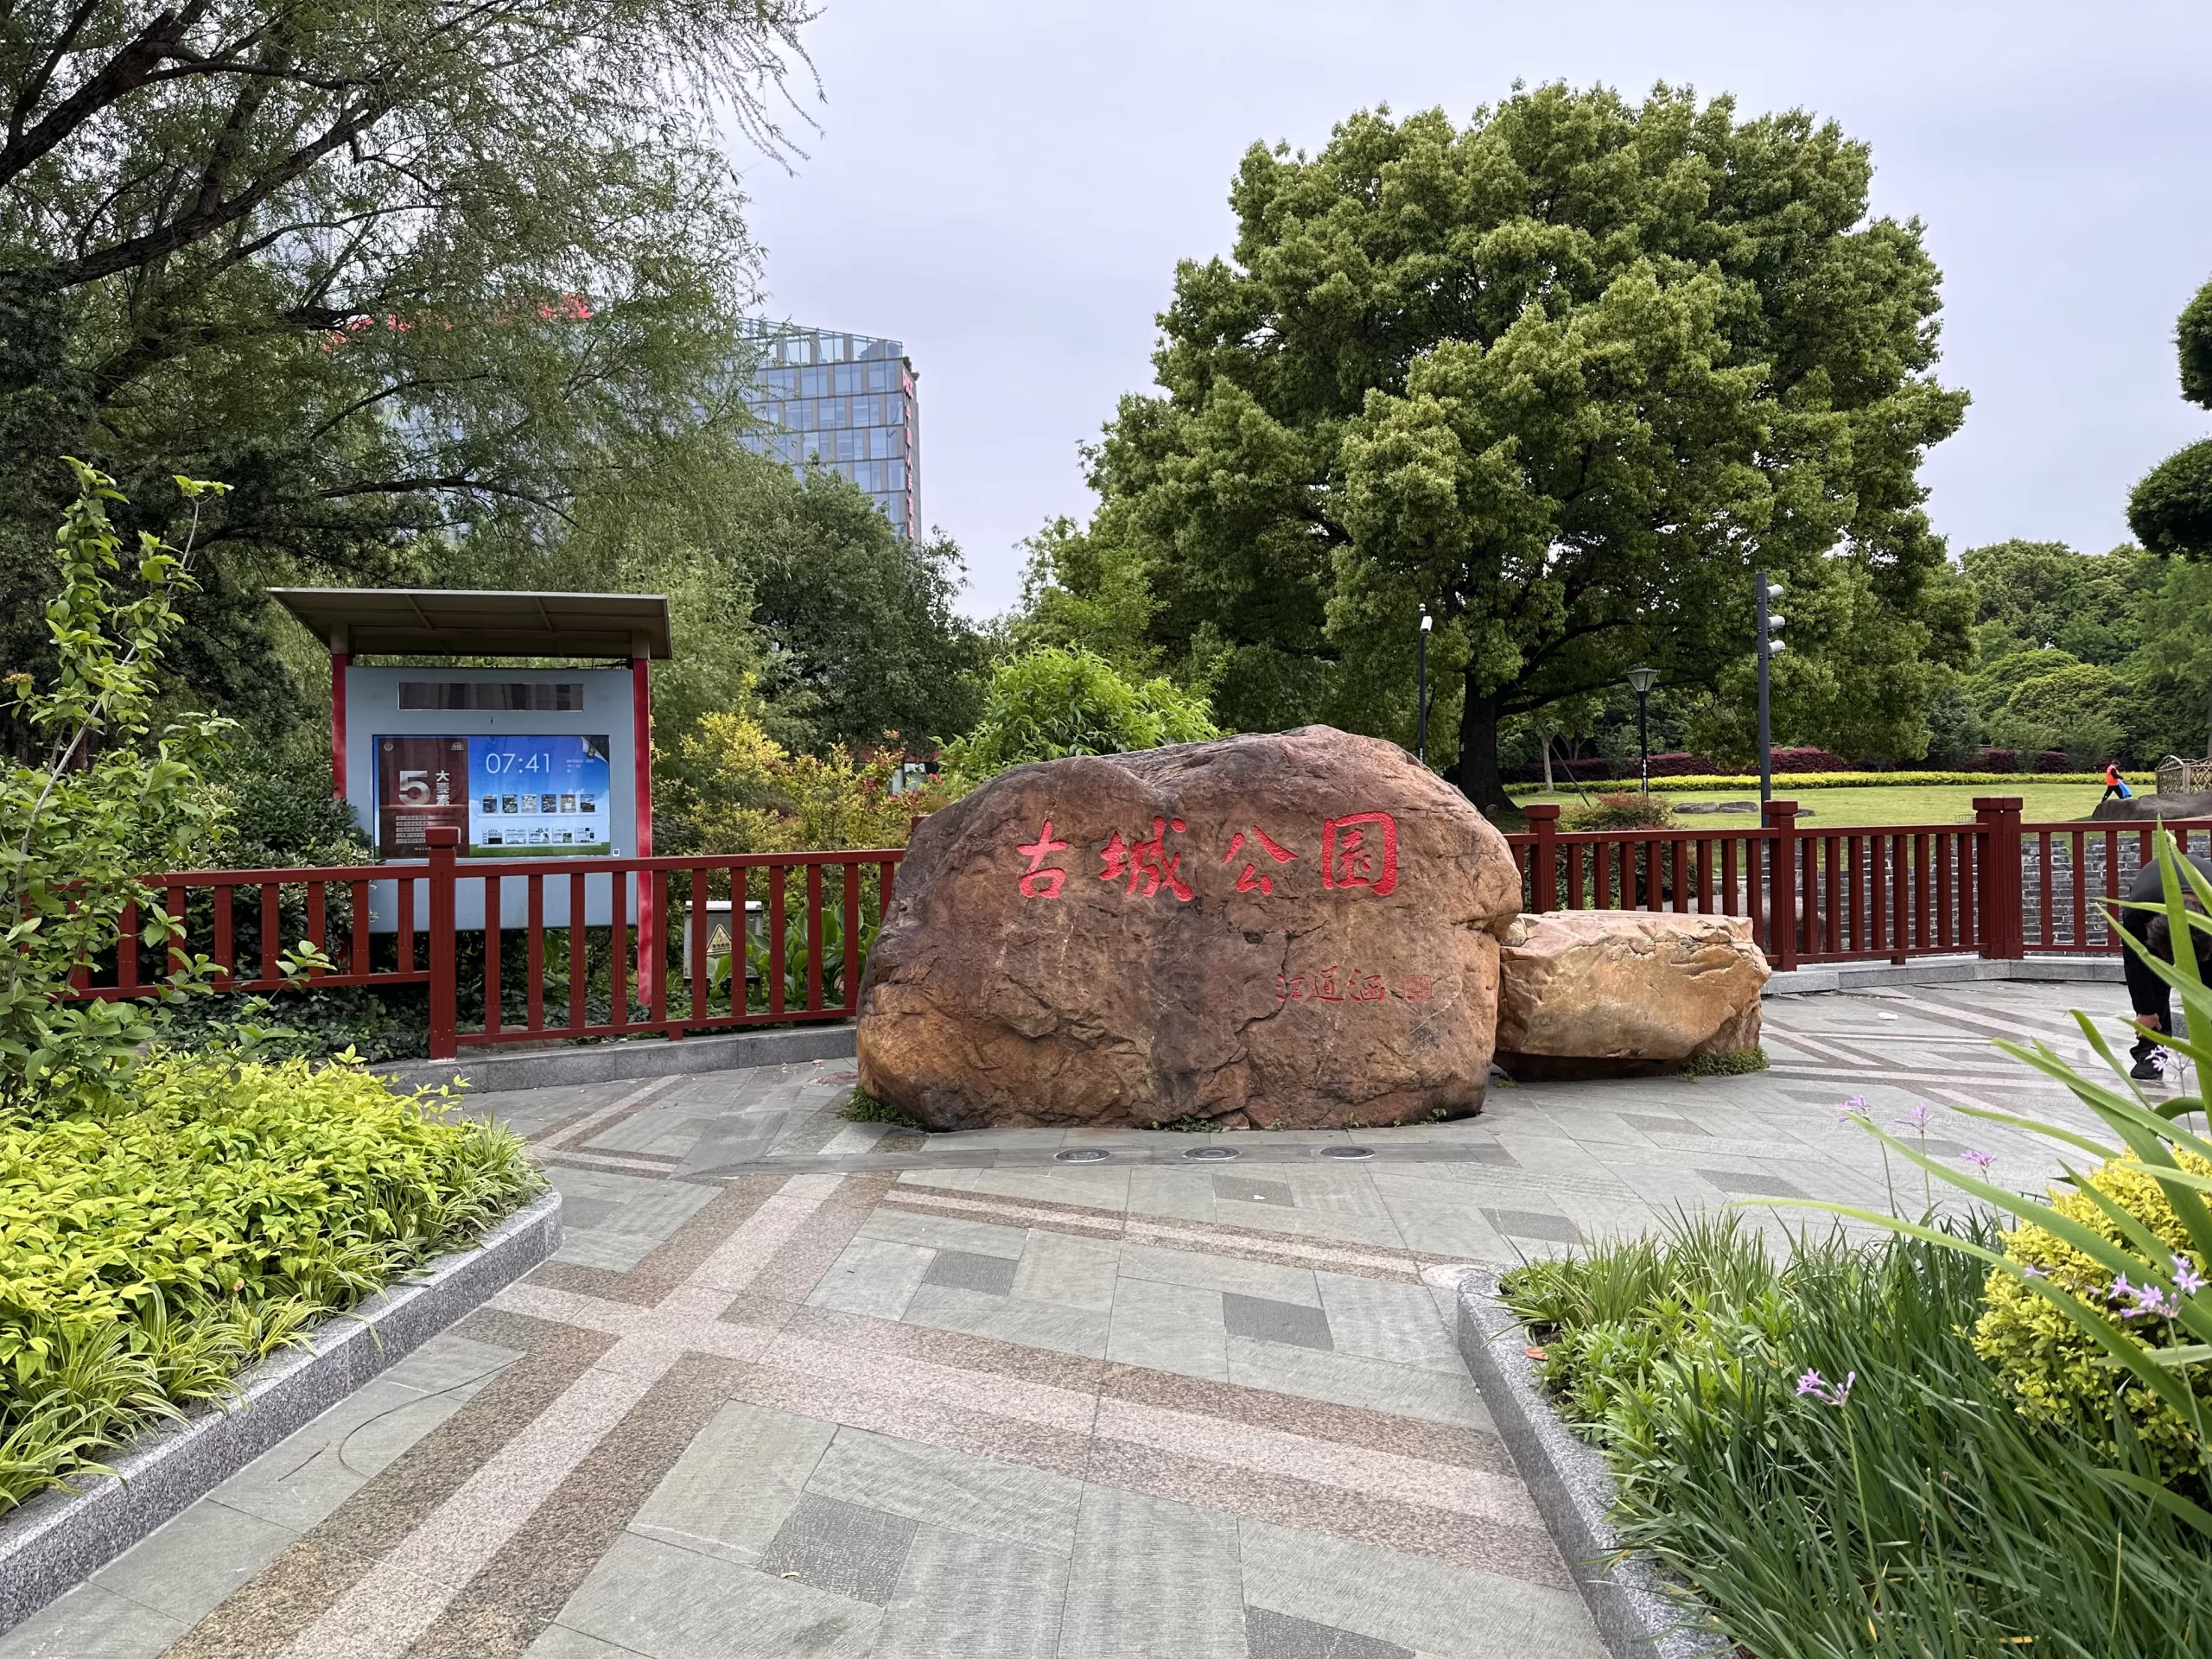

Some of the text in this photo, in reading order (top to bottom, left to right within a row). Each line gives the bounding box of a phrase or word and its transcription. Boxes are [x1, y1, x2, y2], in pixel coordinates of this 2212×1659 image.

[486, 753, 550, 773] 07:41
[398, 770, 450, 805] 5 大要素
